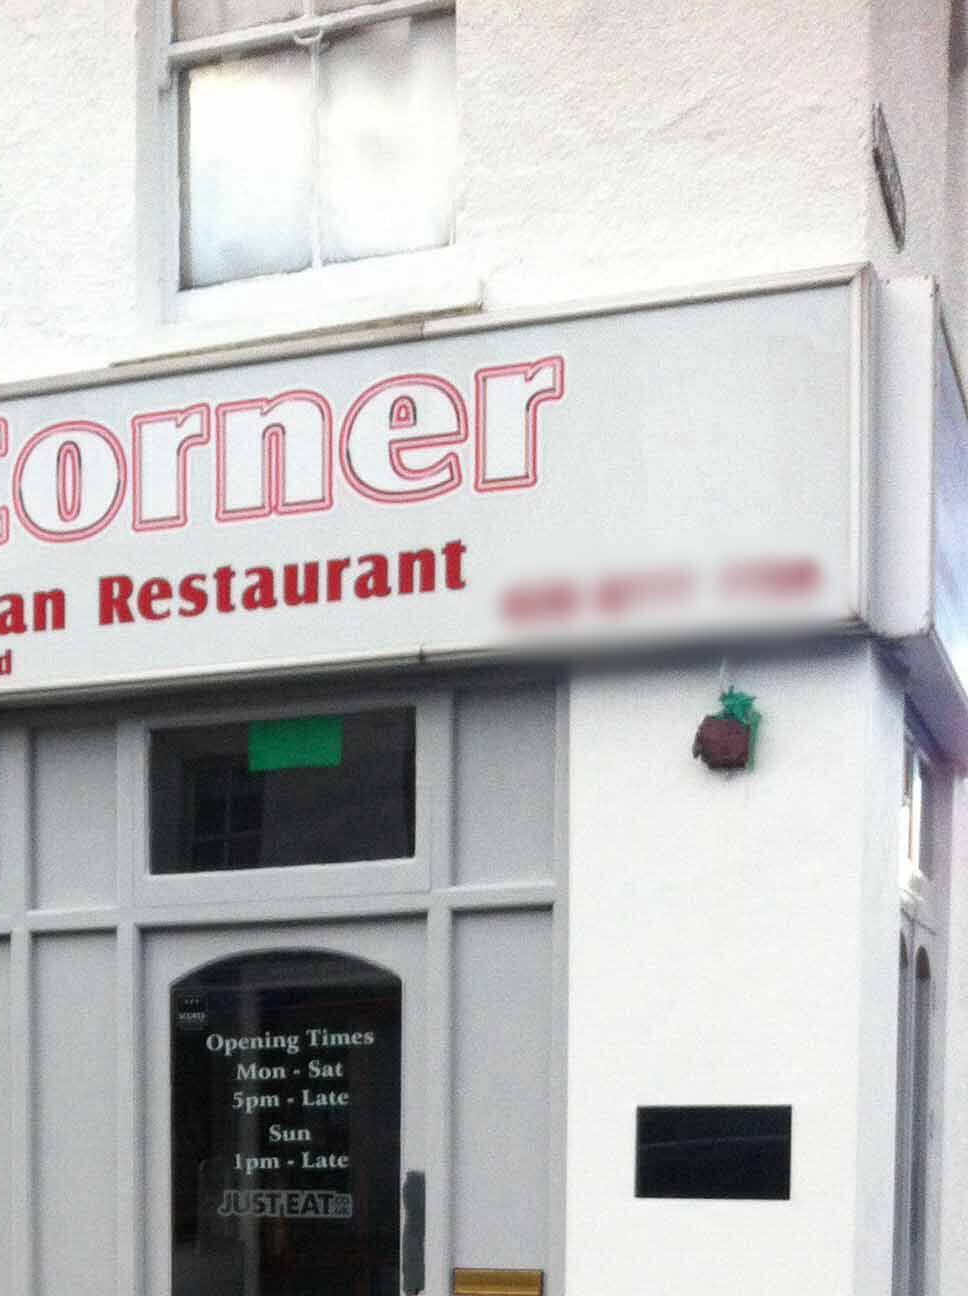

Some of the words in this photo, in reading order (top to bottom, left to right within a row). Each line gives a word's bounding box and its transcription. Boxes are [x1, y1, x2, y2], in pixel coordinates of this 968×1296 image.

[98, 539, 467, 625] Restaurant
[206, 1032, 300, 1056] Opening
[306, 1029, 375, 1047] Times
[236, 1062, 286, 1080] Mon
[308, 1060, 343, 1078] Sat
[232, 1092, 280, 1114] 5pm
[302, 1089, 349, 1106] Late
[269, 1124, 311, 1142] Sun
[235, 1153, 280, 1175] 1pm
[302, 1152, 349, 1168] Late
